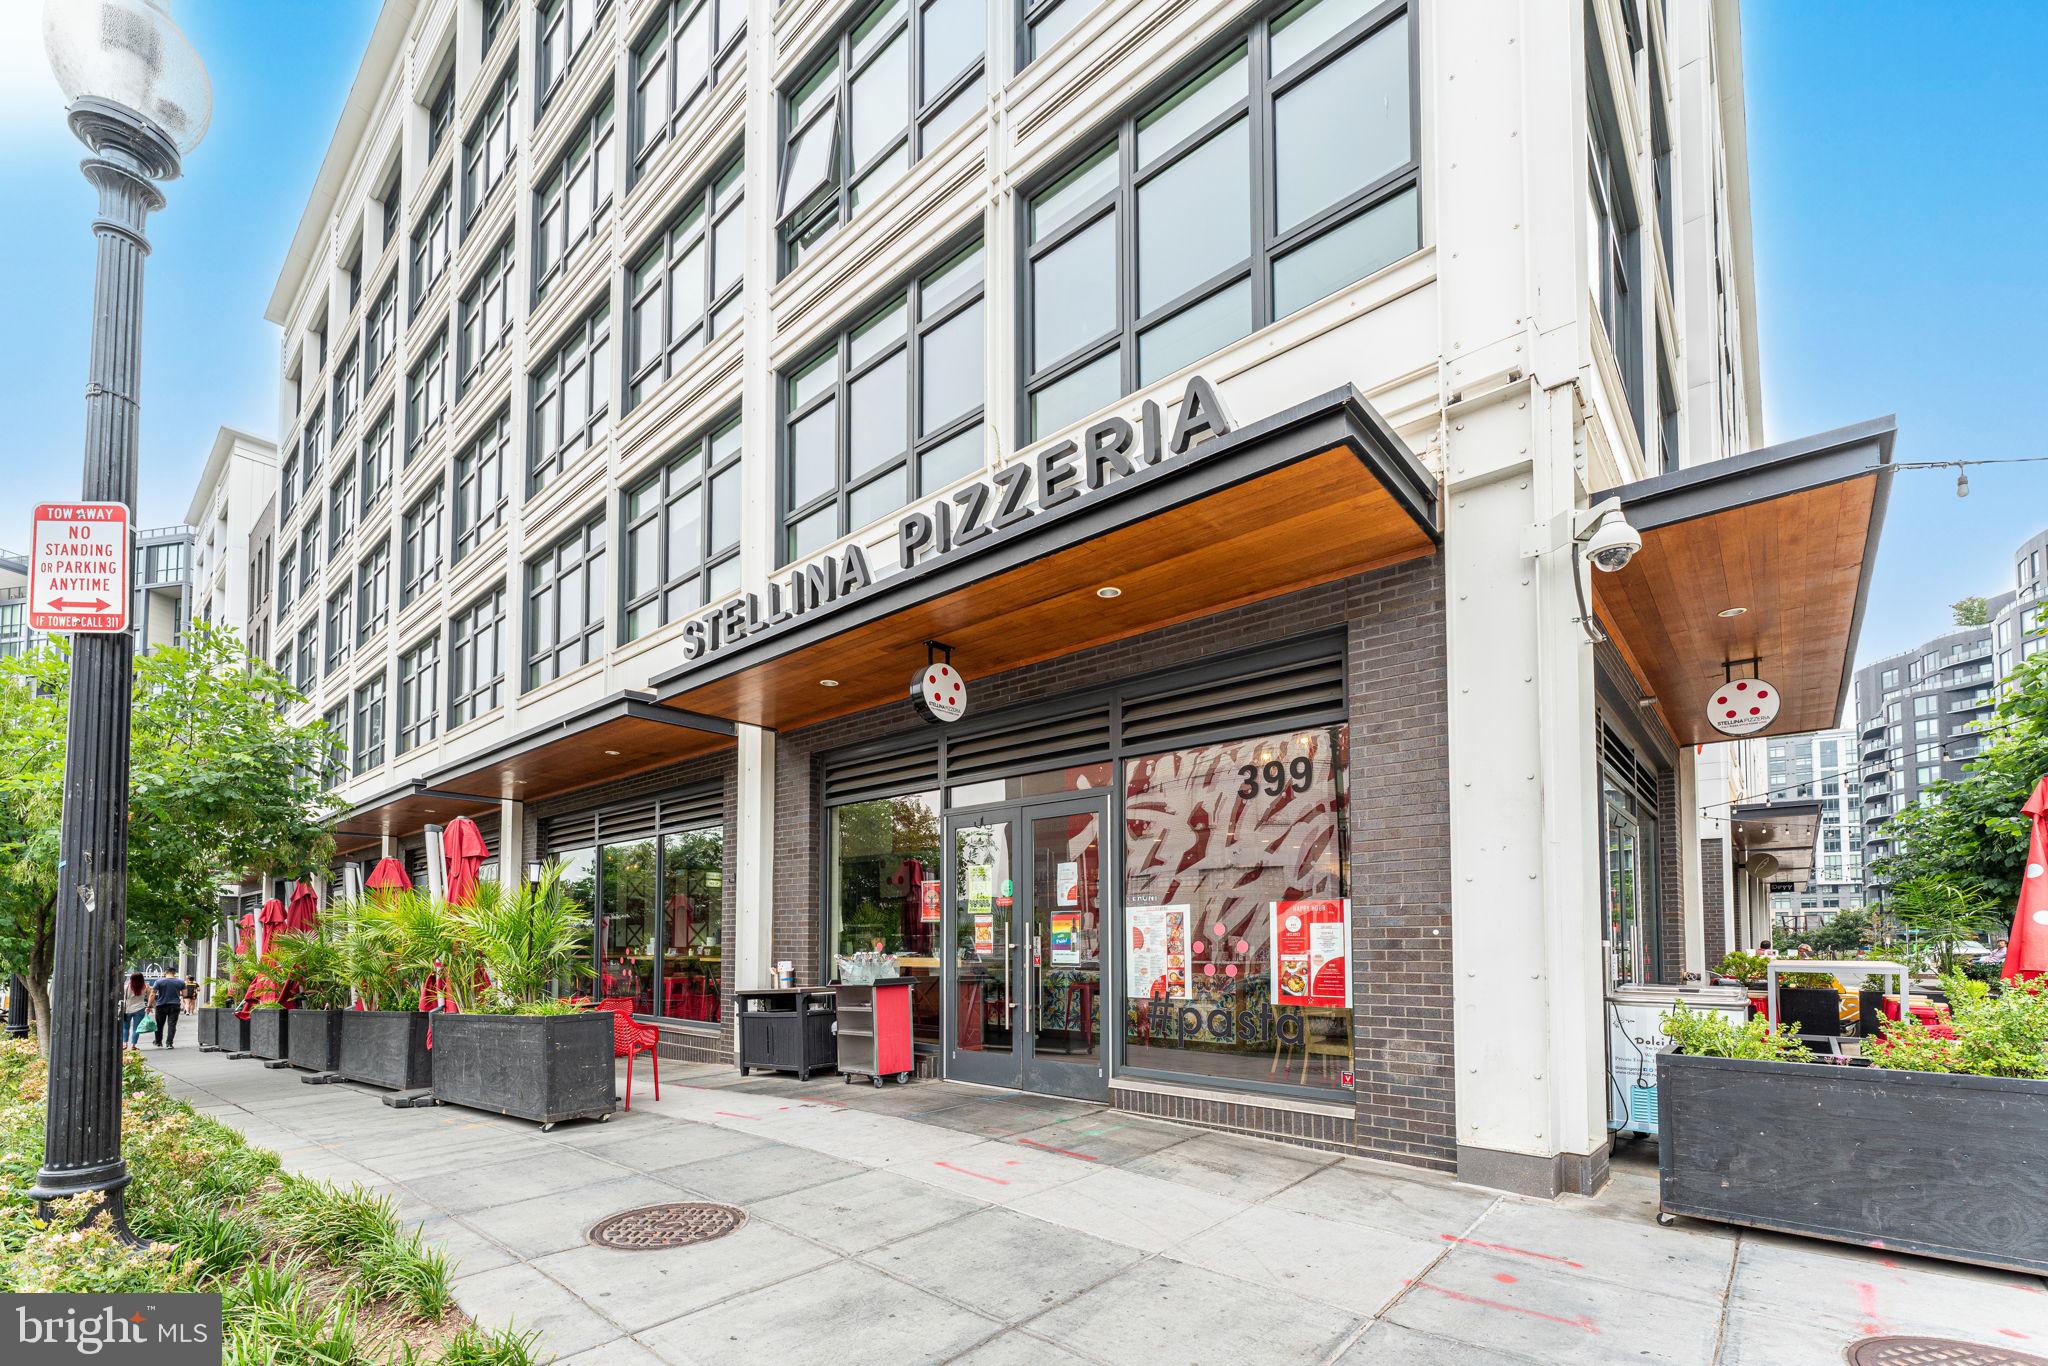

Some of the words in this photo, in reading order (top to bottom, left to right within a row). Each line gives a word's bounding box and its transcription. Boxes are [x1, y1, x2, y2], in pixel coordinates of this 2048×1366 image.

[47, 507, 72, 519] TOW
[76, 508, 114, 520] AWAY
[682, 543, 873, 660] STELLINA
[899, 375, 1232, 570] PIZZERIA
[69, 525, 91, 539] NO
[45, 543, 113, 557] STANDING
[40, 562, 53, 573] OR
[56, 560, 117, 574] PARKING
[49, 577, 110, 591] ANYTIME
[36, 617, 45, 626] IF
[48, 617, 77, 627] TOWED
[81, 617, 103, 627] CALL
[106, 617, 119, 628] 311
[1717, 718, 1744, 727] STELLINA
[1744, 715, 1771, 723] PIZZERIA
[1237, 756, 1313, 799] 399
[1148, 991, 1305, 1049] #pasta
[1635, 1035, 1665, 1046] Dolci
